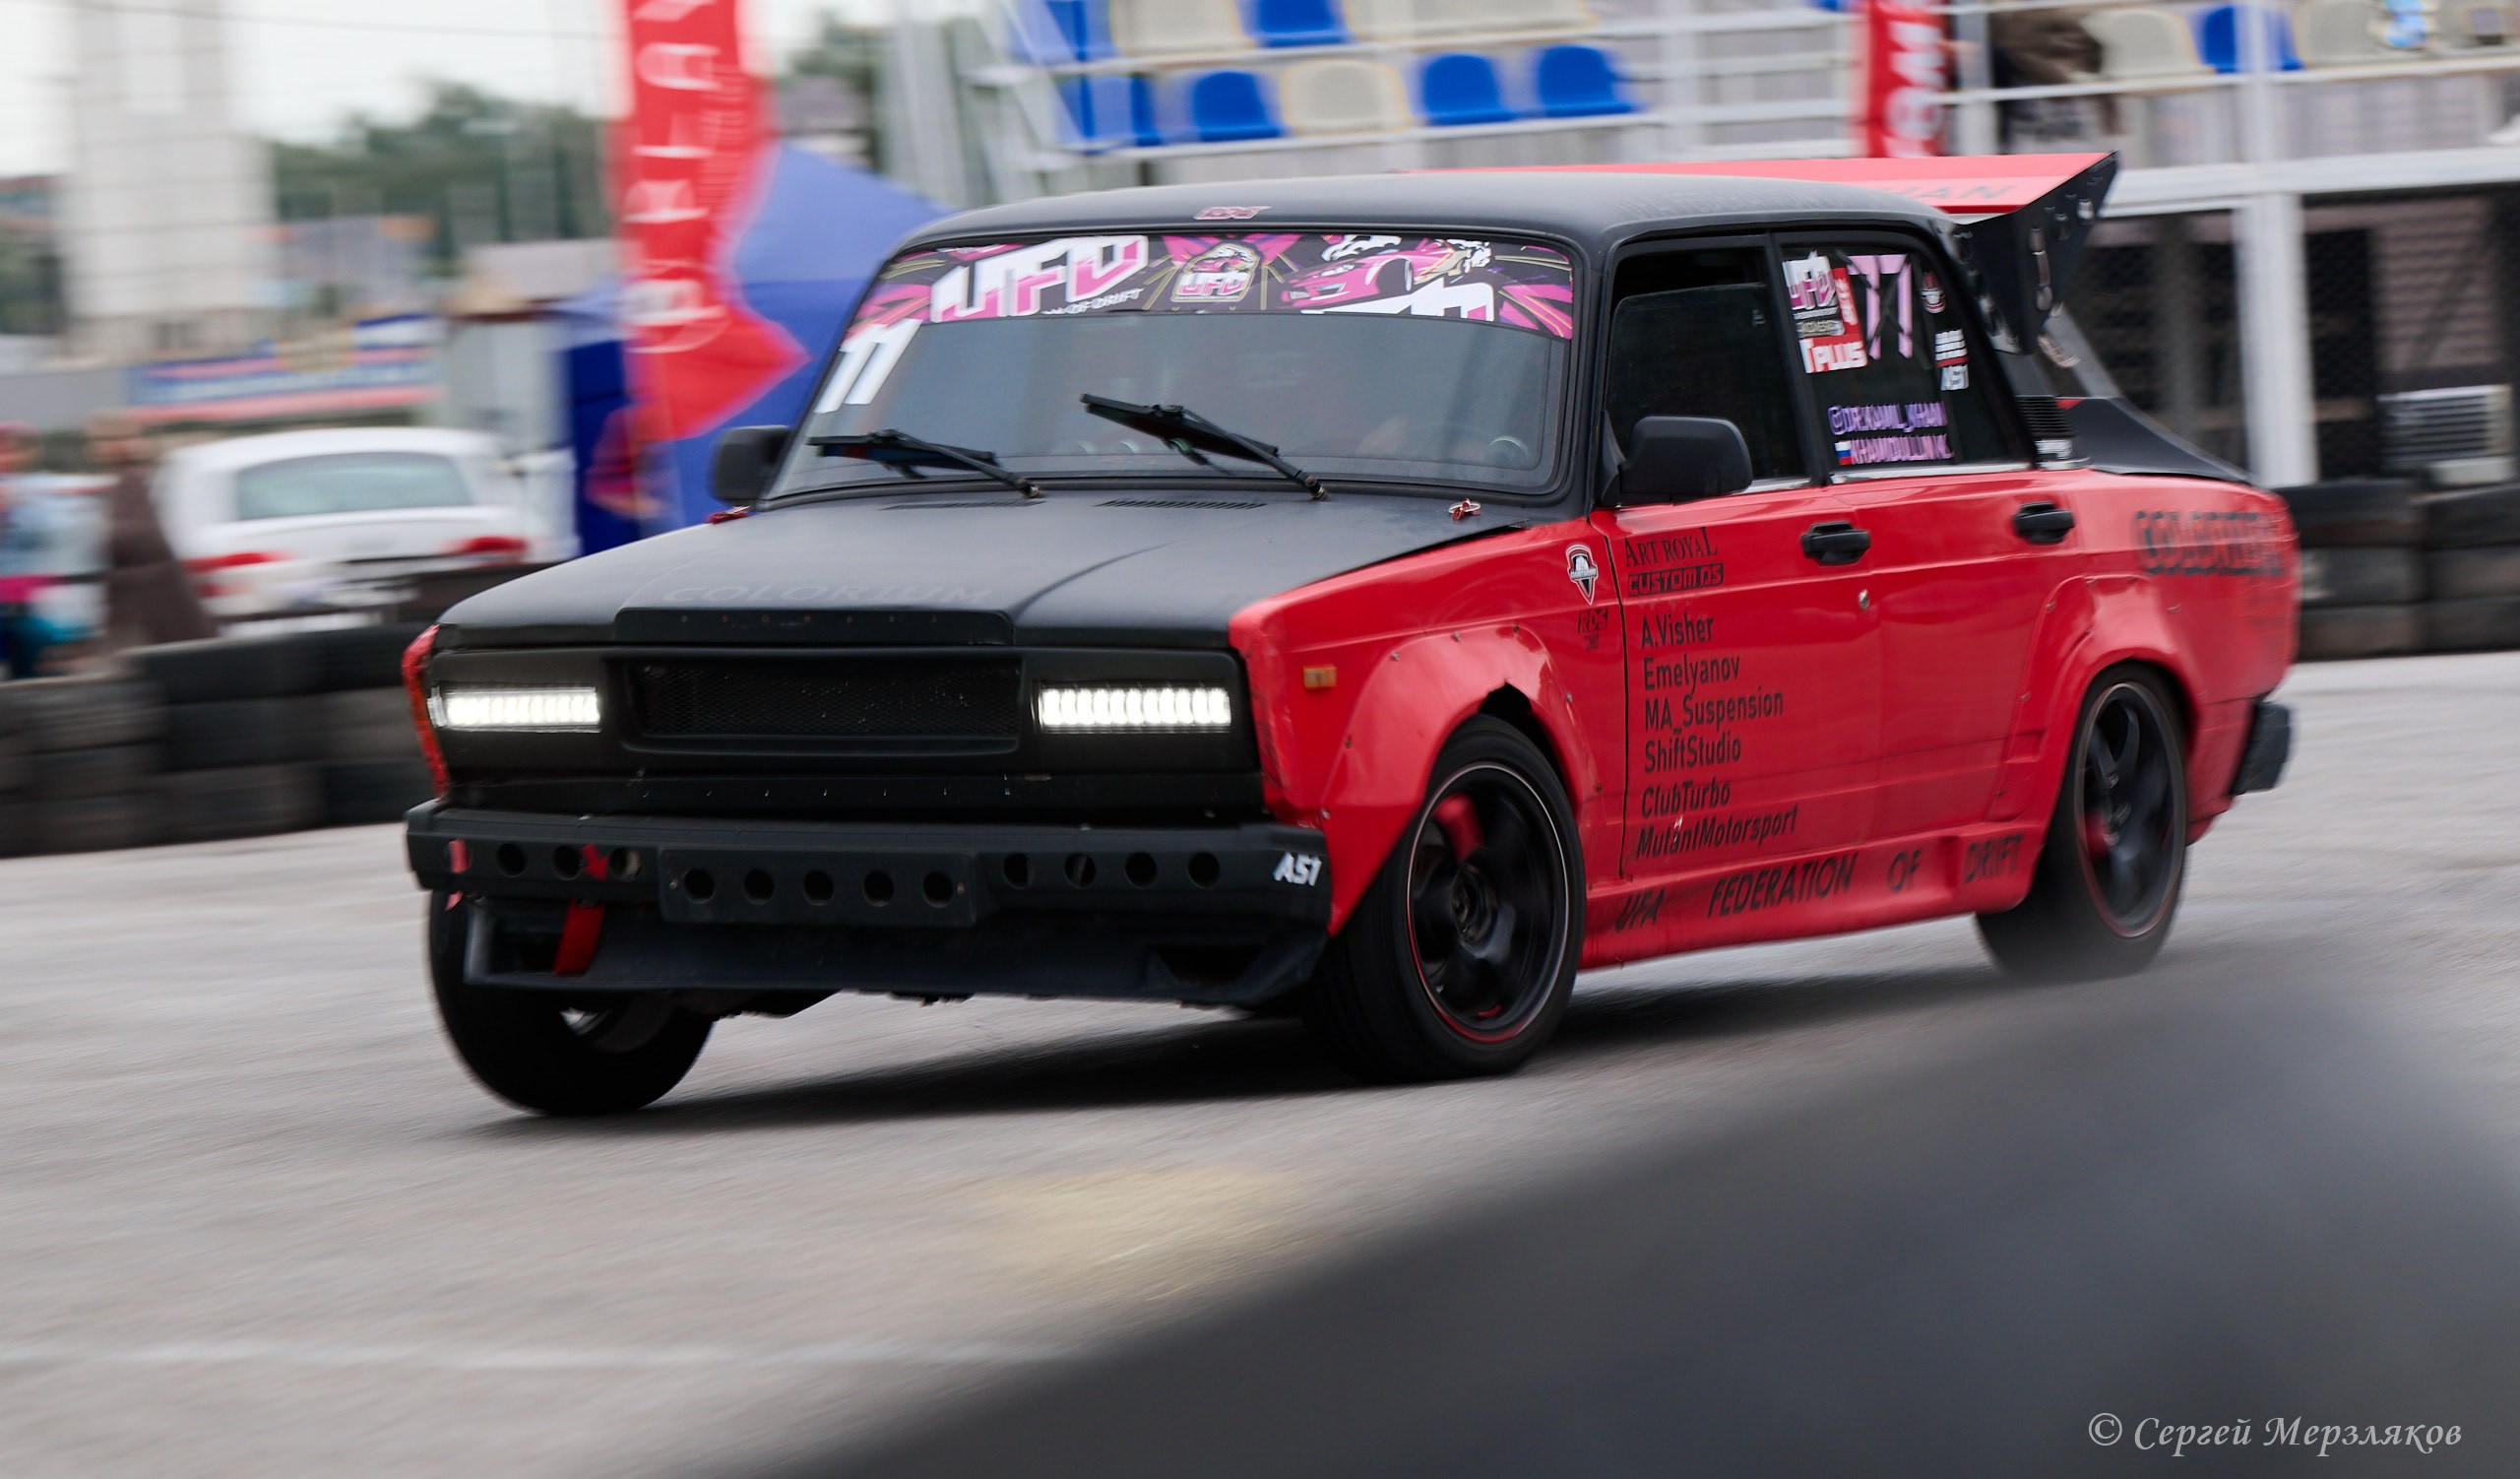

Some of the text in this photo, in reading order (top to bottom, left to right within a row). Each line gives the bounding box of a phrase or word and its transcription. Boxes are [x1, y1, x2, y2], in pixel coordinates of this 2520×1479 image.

[1624, 526, 1718, 567] ART ROYAL
[1628, 567, 1698, 597] CUSTOM
[1641, 614, 1715, 650] A.Visher
[1643, 654, 1741, 694] Emelyanov
[1645, 687, 1785, 735] MA_Suspension
[1644, 735, 1742, 774] ShiftStudio
[1641, 776, 1732, 819] ClubTurbo
[1635, 806, 1799, 863] MutantMotorsport
[1614, 835, 2024, 932] UFA FEDERATION OF DRIFT
